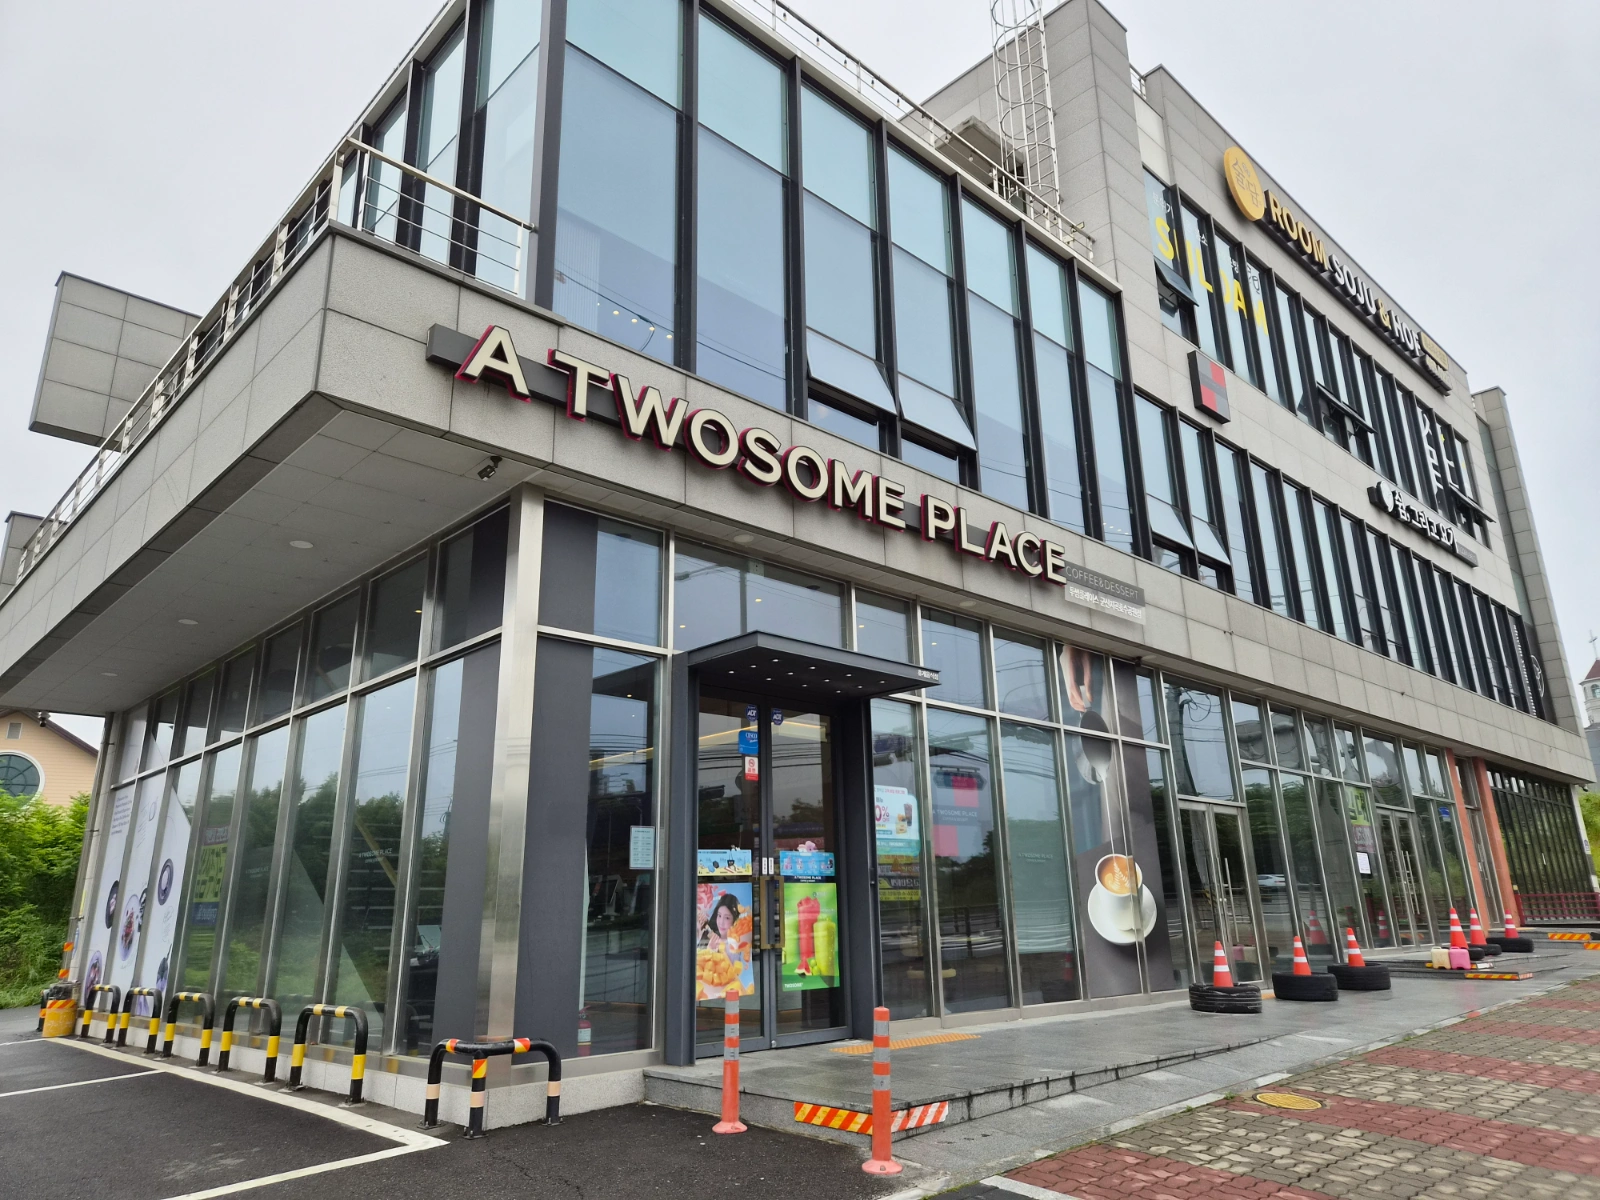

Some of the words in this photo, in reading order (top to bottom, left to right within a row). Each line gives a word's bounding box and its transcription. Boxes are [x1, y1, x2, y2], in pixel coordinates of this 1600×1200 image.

[1265, 189, 1329, 271] ROOM
[1329, 253, 1377, 315] SOJU
[1376, 298, 1392, 331] &
[1388, 309, 1421, 357] HOF
[456, 324, 531, 402] A
[548, 348, 907, 532] TWOSOME
[920, 493, 1067, 586] PLACE
[747, 709, 757, 717] ADT
